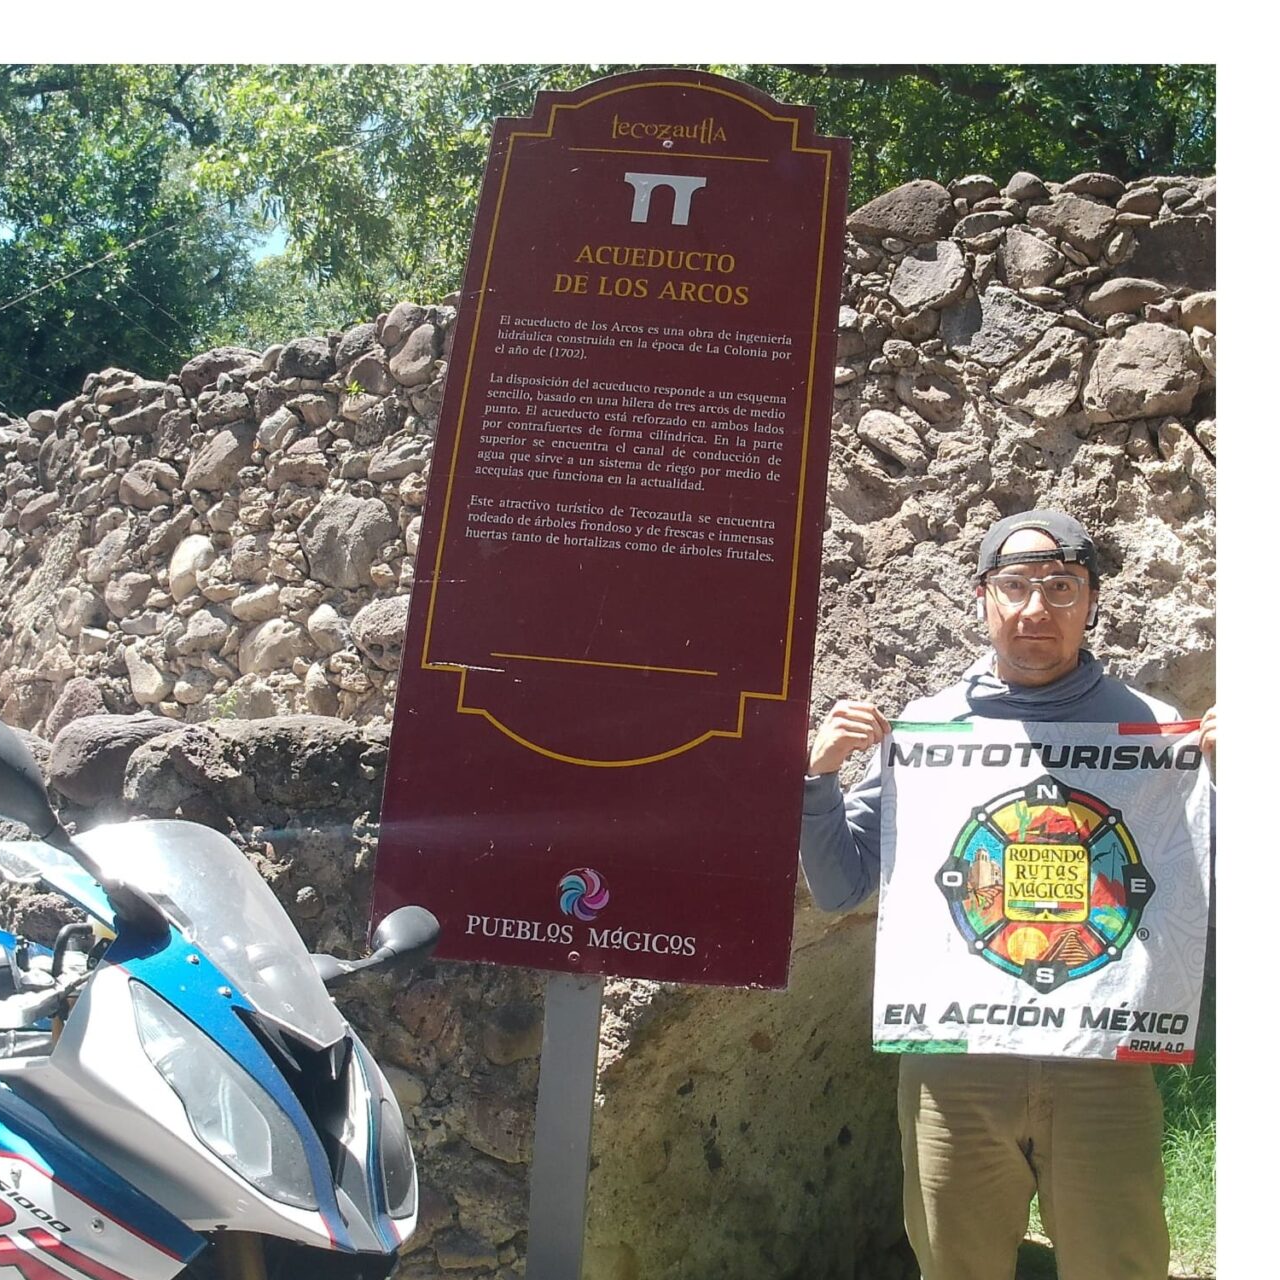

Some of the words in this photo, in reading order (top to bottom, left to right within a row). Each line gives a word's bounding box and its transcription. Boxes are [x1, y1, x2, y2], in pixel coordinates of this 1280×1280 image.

[574, 245, 735, 273] ACUEDUCTO
[552, 274, 588, 294] DE
[598, 276, 648, 298] LOS
[657, 281, 748, 306] ARCOS
[500, 315, 511, 325] El
[514, 317, 571, 329] acueducto
[574, 319, 588, 330] de
[591, 320, 608, 331] los
[611, 322, 643, 333] Arcos
[663, 328, 684, 336] una
[688, 327, 714, 338] obra
[718, 329, 732, 340] de
[494, 343, 505, 354] el
[508, 345, 529, 355] año
[532, 346, 546, 356] de
[549, 346, 587, 360] (1702).
[498, 329, 552, 342] hidráulica
[556, 335, 615, 346] construida
[619, 339, 633, 347] en
[637, 338, 648, 349] la
[652, 339, 684, 352] época
[689, 342, 702, 352] de
[706, 343, 720, 354] La
[724, 345, 767, 358] Colonia
[772, 350, 792, 361] por
[475, 465, 524, 478] acequias
[527, 470, 549, 480] que
[553, 468, 604, 483] funciona
[607, 475, 622, 484] en
[626, 474, 636, 485] la
[640, 477, 705, 491] actualidad.
[470, 495, 494, 507] Este
[499, 499, 550, 511] atractivo
[556, 502, 604, 515] turístico
[610, 505, 624, 517] de
[629, 506, 692, 522] Tecozautla
[698, 515, 711, 524] se
[716, 517, 775, 529] encuentra
[468, 511, 514, 524] rodeado
[517, 514, 531, 526] de
[534, 516, 577, 529] árboles
[580, 519, 632, 534] frondoso
[634, 526, 644, 537] y
[646, 524, 661, 536] de
[664, 525, 705, 539] frescas
[708, 532, 715, 541] e
[718, 530, 774, 546] inmensas
[465, 526, 508, 540] huertas
[511, 531, 542, 543] tanto
[545, 532, 560, 544] de
[564, 533, 621, 549] hortalizas
[625, 542, 657, 552] como
[661, 542, 676, 553] de
[679, 543, 722, 558] árboles
[727, 547, 774, 562] frutales.
[888, 742, 1203, 771] MOTOTURISMO
[1036, 784, 1058, 799] N
[941, 871, 963, 887] O
[1129, 878, 1147, 893] E
[1035, 967, 1055, 983] S
[884, 1003, 927, 1025] EN
[939, 998, 1065, 1029] ACCIÓN
[1080, 1002, 1190, 1035] MÉXICO
[1129, 1039, 1164, 1052] RRM
[1164, 1042, 1185, 1054] 4.0
